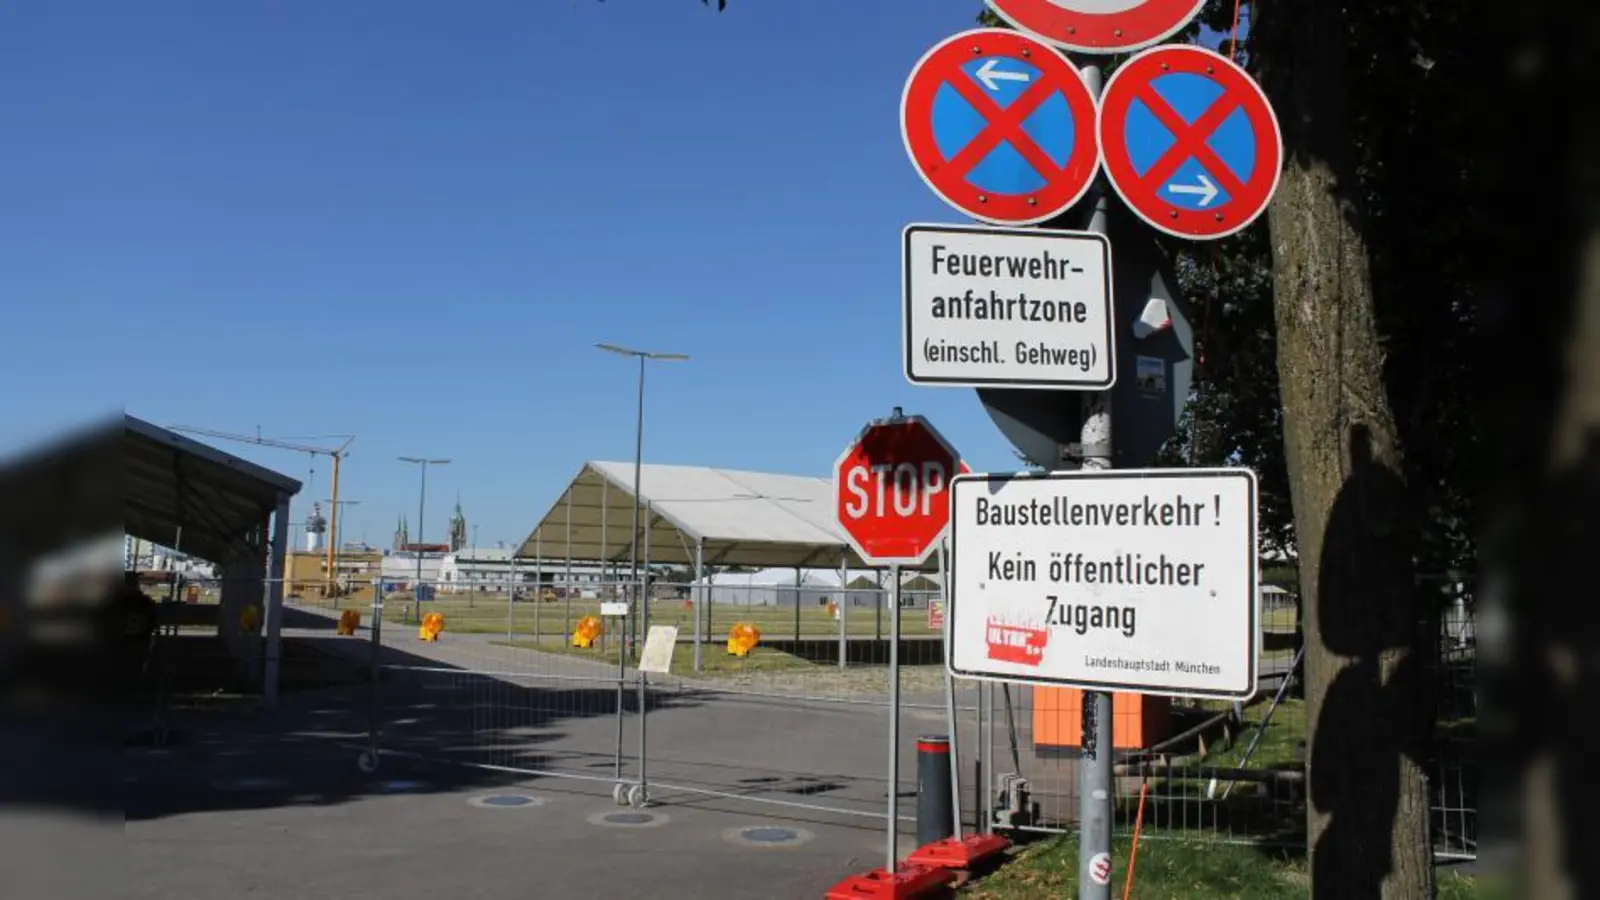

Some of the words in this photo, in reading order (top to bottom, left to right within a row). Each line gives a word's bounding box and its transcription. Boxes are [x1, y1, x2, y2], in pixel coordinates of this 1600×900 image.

[932, 245, 1084, 281] Feuerwehr-
[931, 289, 1087, 324] anfahrtzone
[923, 337, 1005, 364] (einschl.
[1015, 341, 1097, 373] Gehweg)
[846, 461, 945, 518] STOP
[988, 551, 1036, 582] Kein
[1049, 552, 1205, 586] öffentlicher
[1045, 595, 1136, 637] Zugang
[1084, 655, 1171, 672] Landeshauptstadt
[1174, 660, 1221, 675] München
